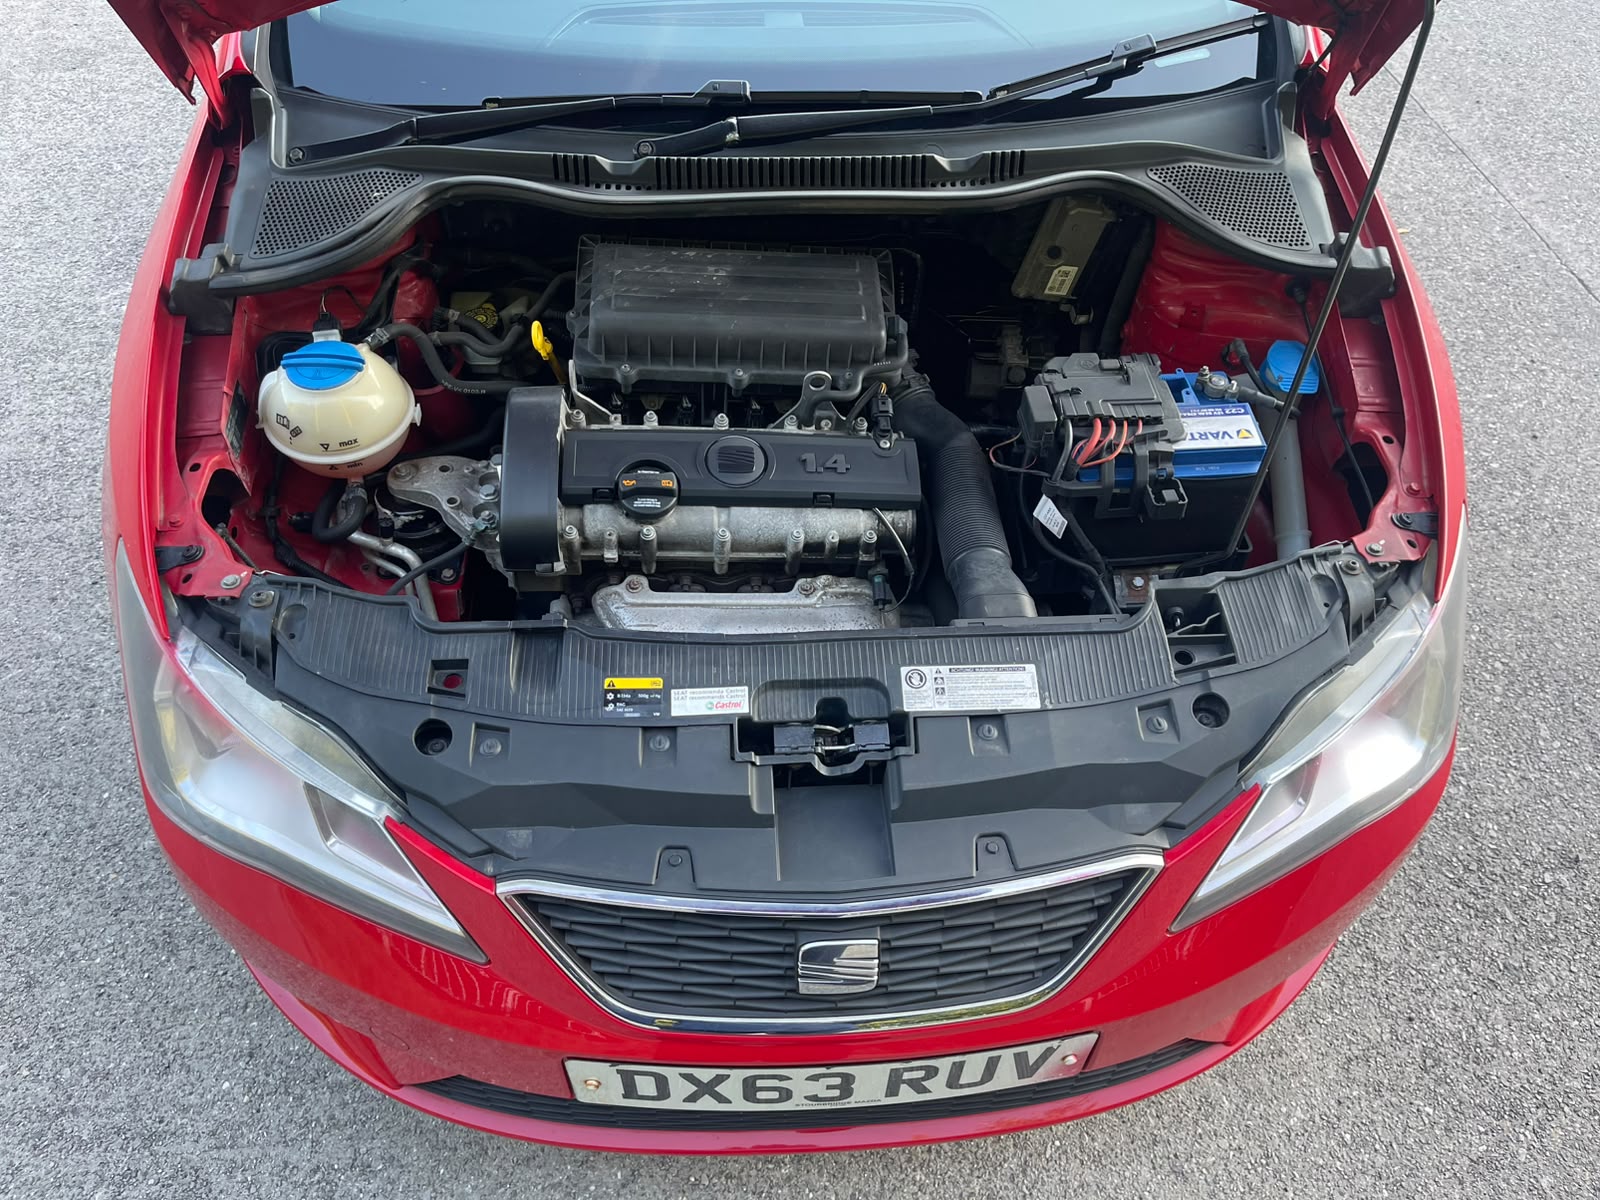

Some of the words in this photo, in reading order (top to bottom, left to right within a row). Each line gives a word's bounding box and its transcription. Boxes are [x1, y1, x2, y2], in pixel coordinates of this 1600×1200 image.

[1187, 430, 1234, 441] VART
[338, 438, 359, 448] max
[801, 453, 851, 473] 1.4
[714, 701, 742, 710] Castrol
[616, 1068, 857, 1104] DX63
[884, 1044, 1062, 1099] RUV
